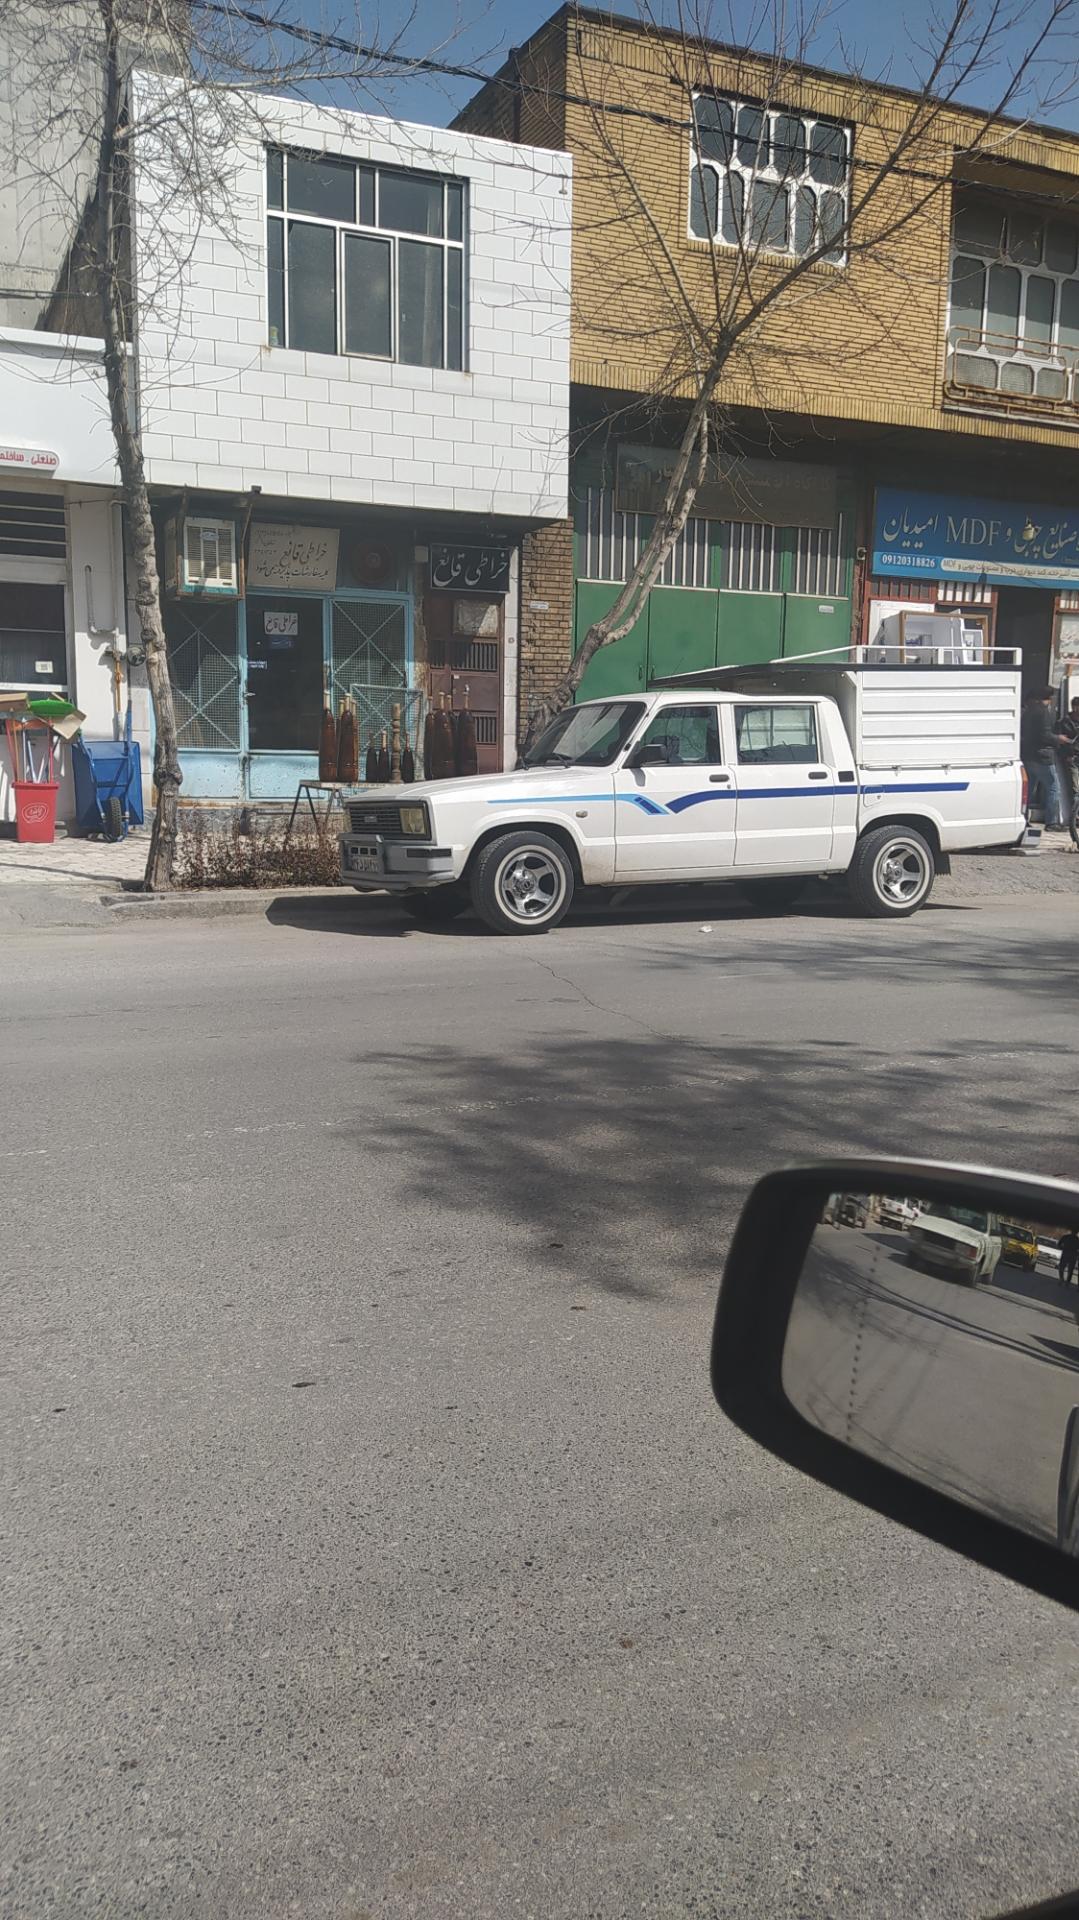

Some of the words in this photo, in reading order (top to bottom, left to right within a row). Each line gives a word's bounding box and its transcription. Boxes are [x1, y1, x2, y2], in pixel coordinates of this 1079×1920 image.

[882, 505, 939, 549] امیدیان
[945, 514, 1002, 546] MDF
[1043, 522, 1078, 559] صنایع
[433, 547, 466, 587] قانع
[464, 551, 508, 586] خراطی
